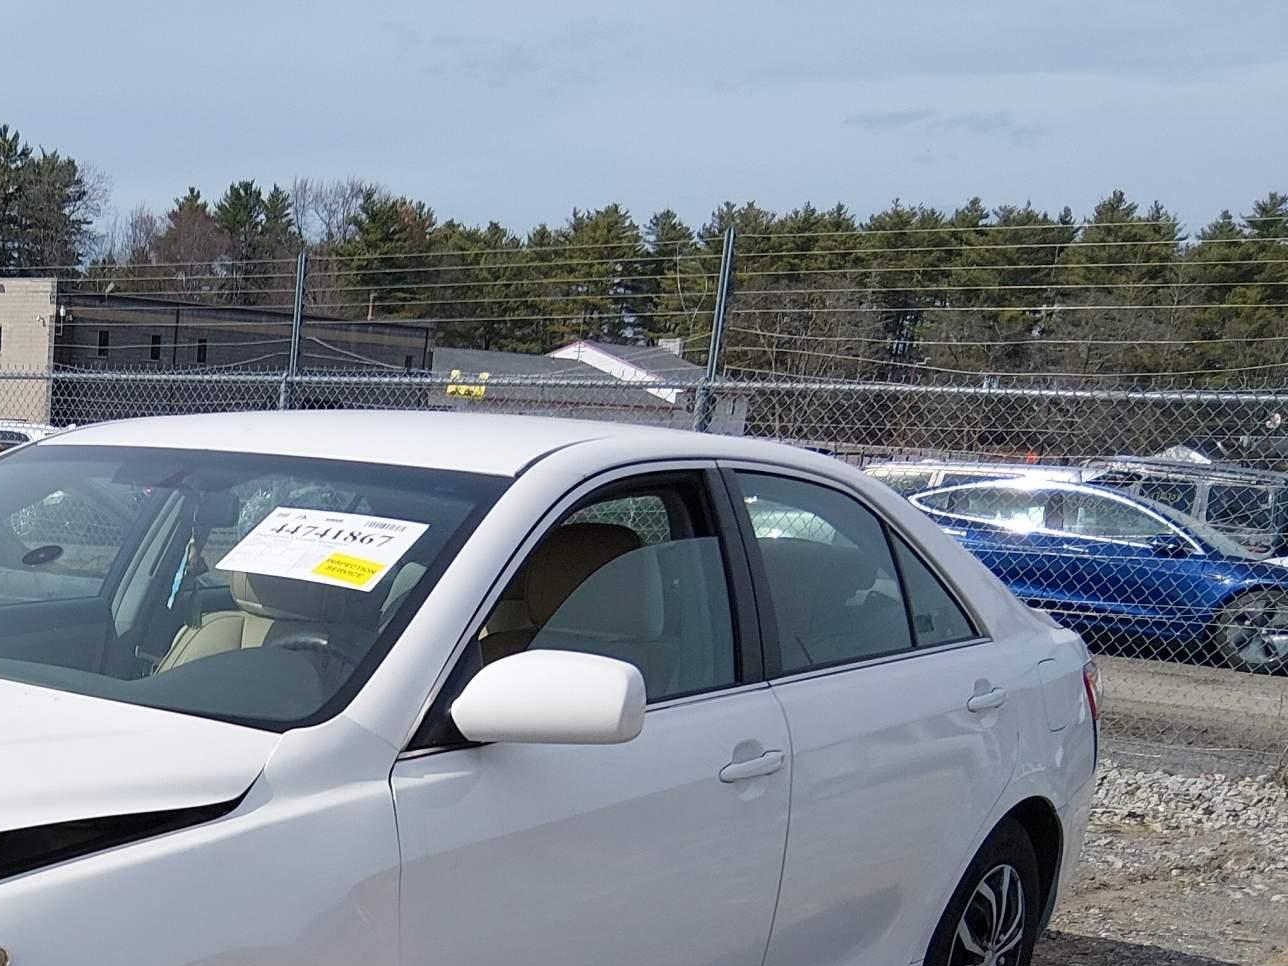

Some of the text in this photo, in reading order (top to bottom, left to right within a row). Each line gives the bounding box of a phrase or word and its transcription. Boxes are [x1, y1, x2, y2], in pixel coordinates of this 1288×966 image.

[270, 522, 395, 547] 44741867
[325, 565, 365, 578] SERVICE
[326, 558, 377, 575] INSPECTION
